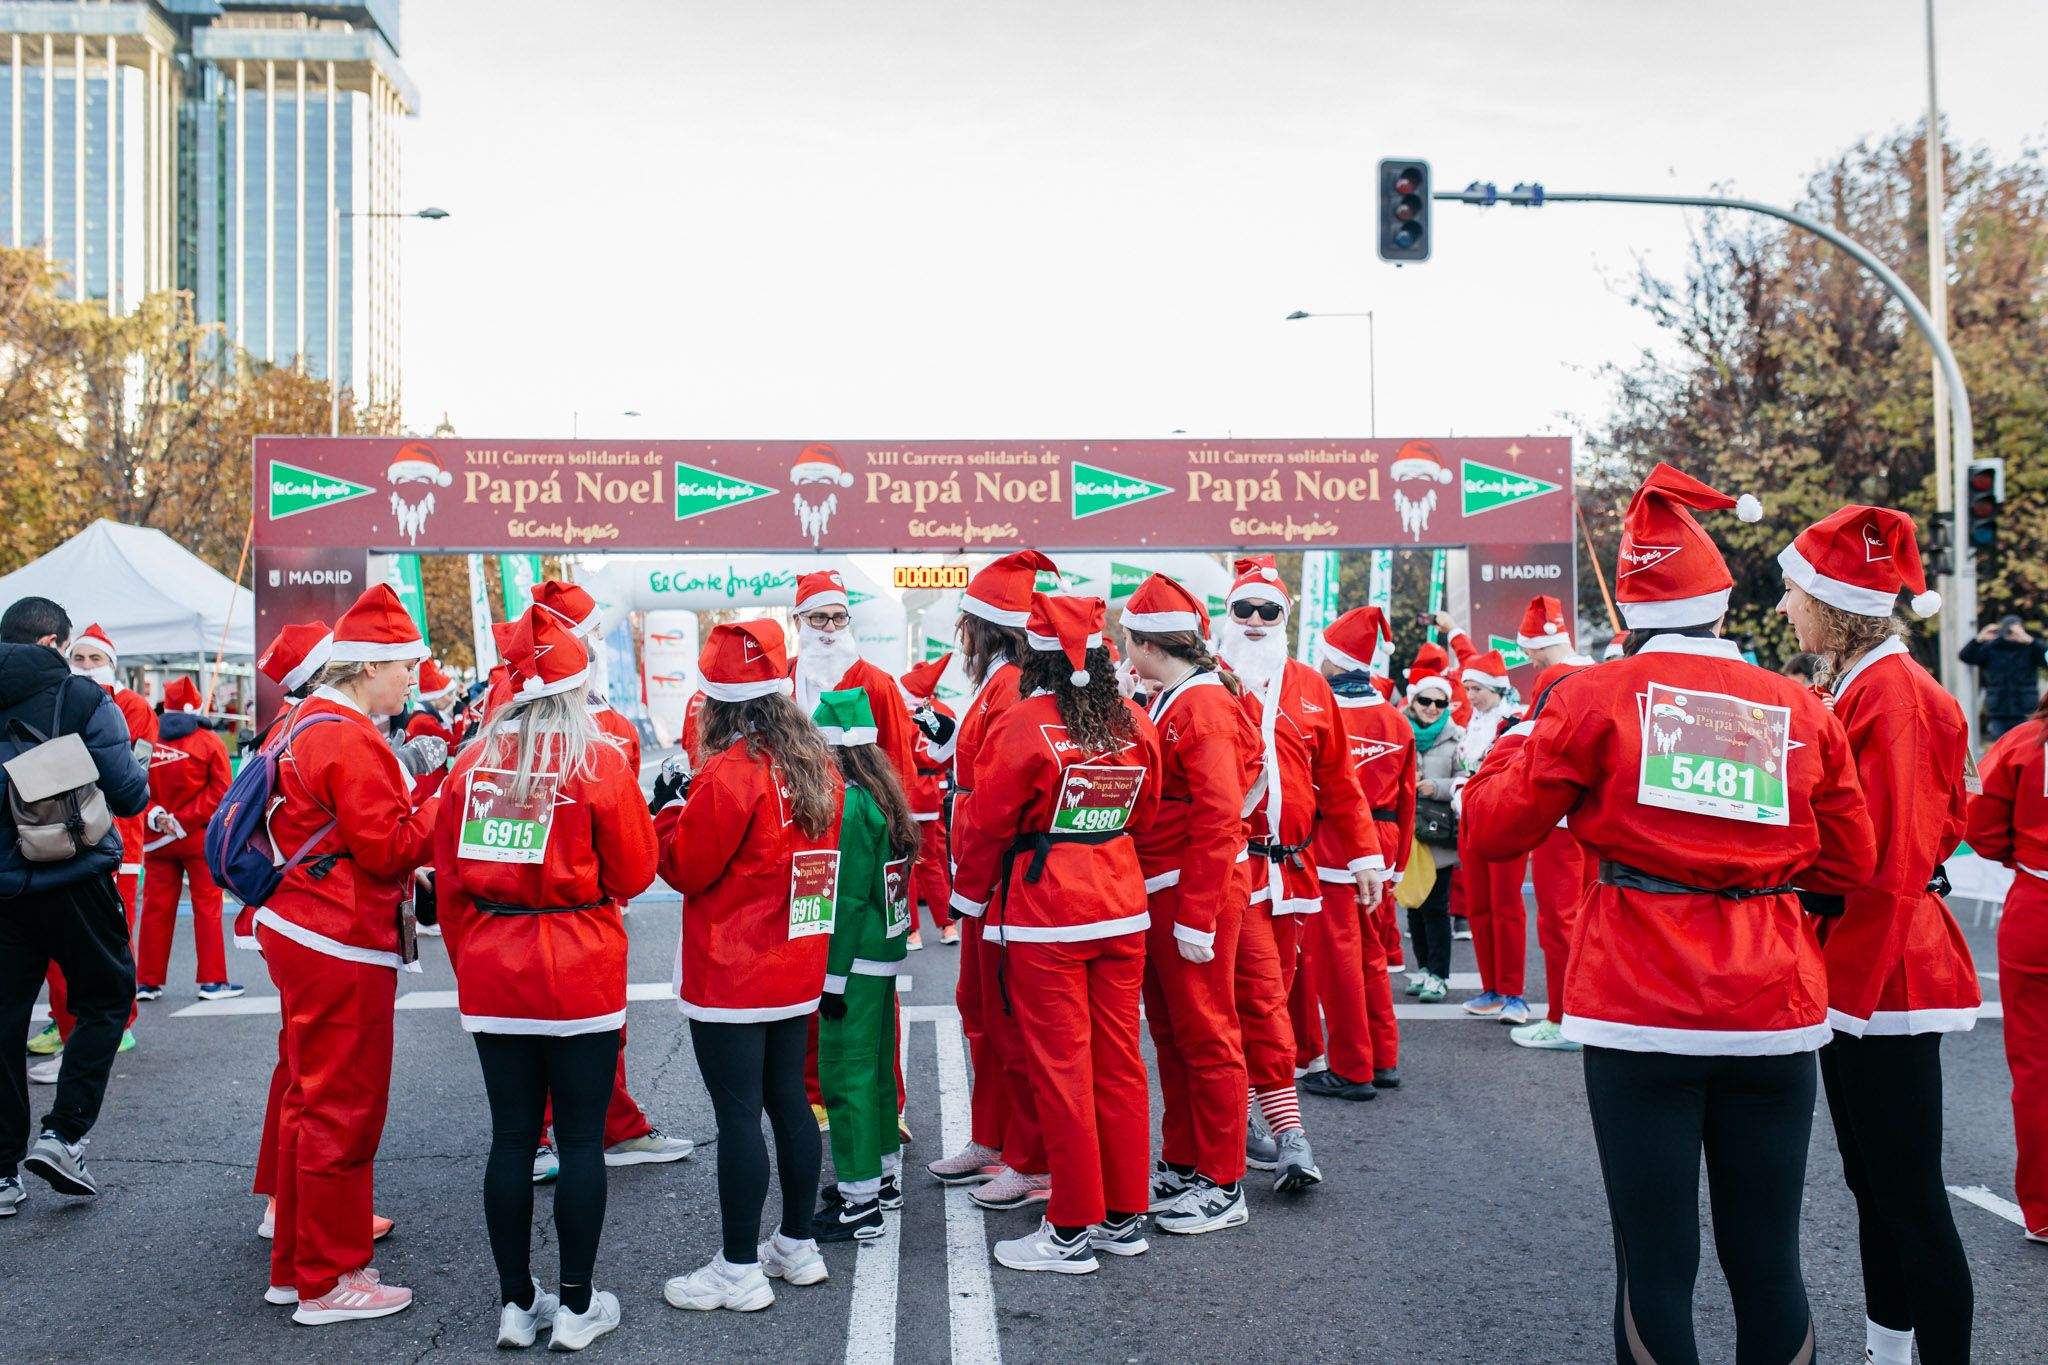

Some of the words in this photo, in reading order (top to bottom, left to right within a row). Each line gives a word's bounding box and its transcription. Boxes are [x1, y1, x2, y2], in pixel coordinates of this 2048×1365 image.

[465, 450, 498, 465] XIII
[502, 450, 564, 465] Carrera
[568, 450, 640, 465] solidaria
[643, 450, 664, 465] de
[866, 452, 899, 465] XIII
[902, 452, 964, 465] Carrera
[967, 451, 1037, 465] solidaria
[1041, 451, 1061, 465] de
[1188, 450, 1220, 464] XIII
[1223, 450, 1284, 464] Carrera
[1286, 449, 1356, 464] solidaria
[1360, 449, 1379, 464] de
[464, 469, 563, 513] Papá
[575, 469, 664, 504] Noel
[865, 470, 963, 513] Papá
[974, 470, 1062, 503] Noel
[1186, 468, 1284, 511] Papá
[1295, 467, 1381, 501] Noel
[508, 519, 525, 538] El
[525, 519, 563, 538] Corte
[563, 517, 619, 544] Inglés
[908, 519, 925, 538] El
[925, 519, 963, 538] Corte
[963, 516, 1018, 544] Inglés
[1230, 517, 1246, 535] El
[1246, 517, 1283, 535] Corte
[1283, 514, 1339, 542] Inglés
[288, 569, 352, 585] MADRID
[650, 571, 670, 592] El
[673, 570, 722, 592] Corte
[726, 565, 796, 597] Inglés
[1500, 564, 1562, 580] MADRID
[1695, 714, 1733, 733] Papá
[1671, 755, 1755, 801] 5481
[1072, 808, 1121, 830] 4980
[483, 819, 534, 848] 6915
[791, 896, 821, 924] 6916
